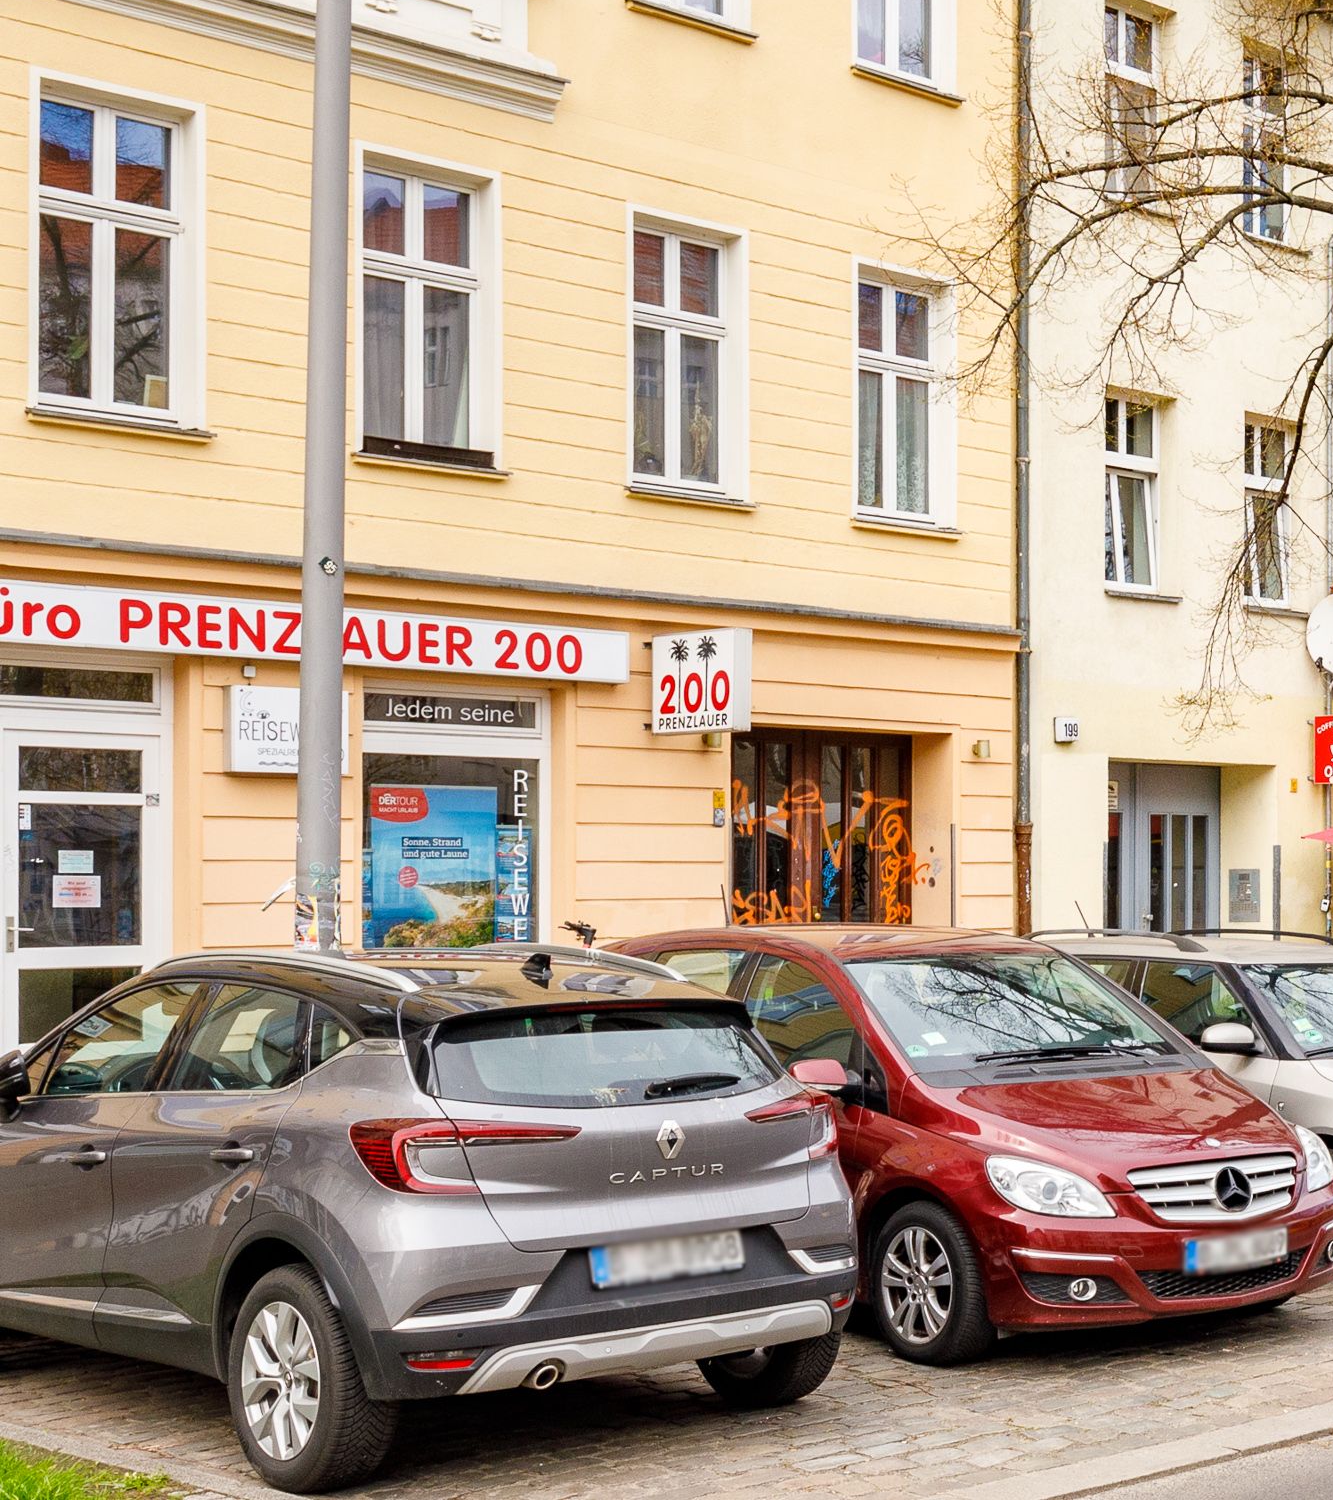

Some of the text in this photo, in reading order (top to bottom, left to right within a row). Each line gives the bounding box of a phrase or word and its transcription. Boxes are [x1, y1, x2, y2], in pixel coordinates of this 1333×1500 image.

[119, 598, 473, 667] PRENZAUER
[494, 629, 583, 674] 200
[660, 670, 730, 714] 200
[385, 698, 515, 723] Jedem seine
[658, 713, 728, 730] PRENZLAUER
[1064, 723, 1079, 737] 199
[432, 837, 462, 847] Strand
[403, 849, 468, 860] und gute Laune
[510, 769, 530, 941] REISEWE
[609, 1163, 724, 1184] CAPTUR
